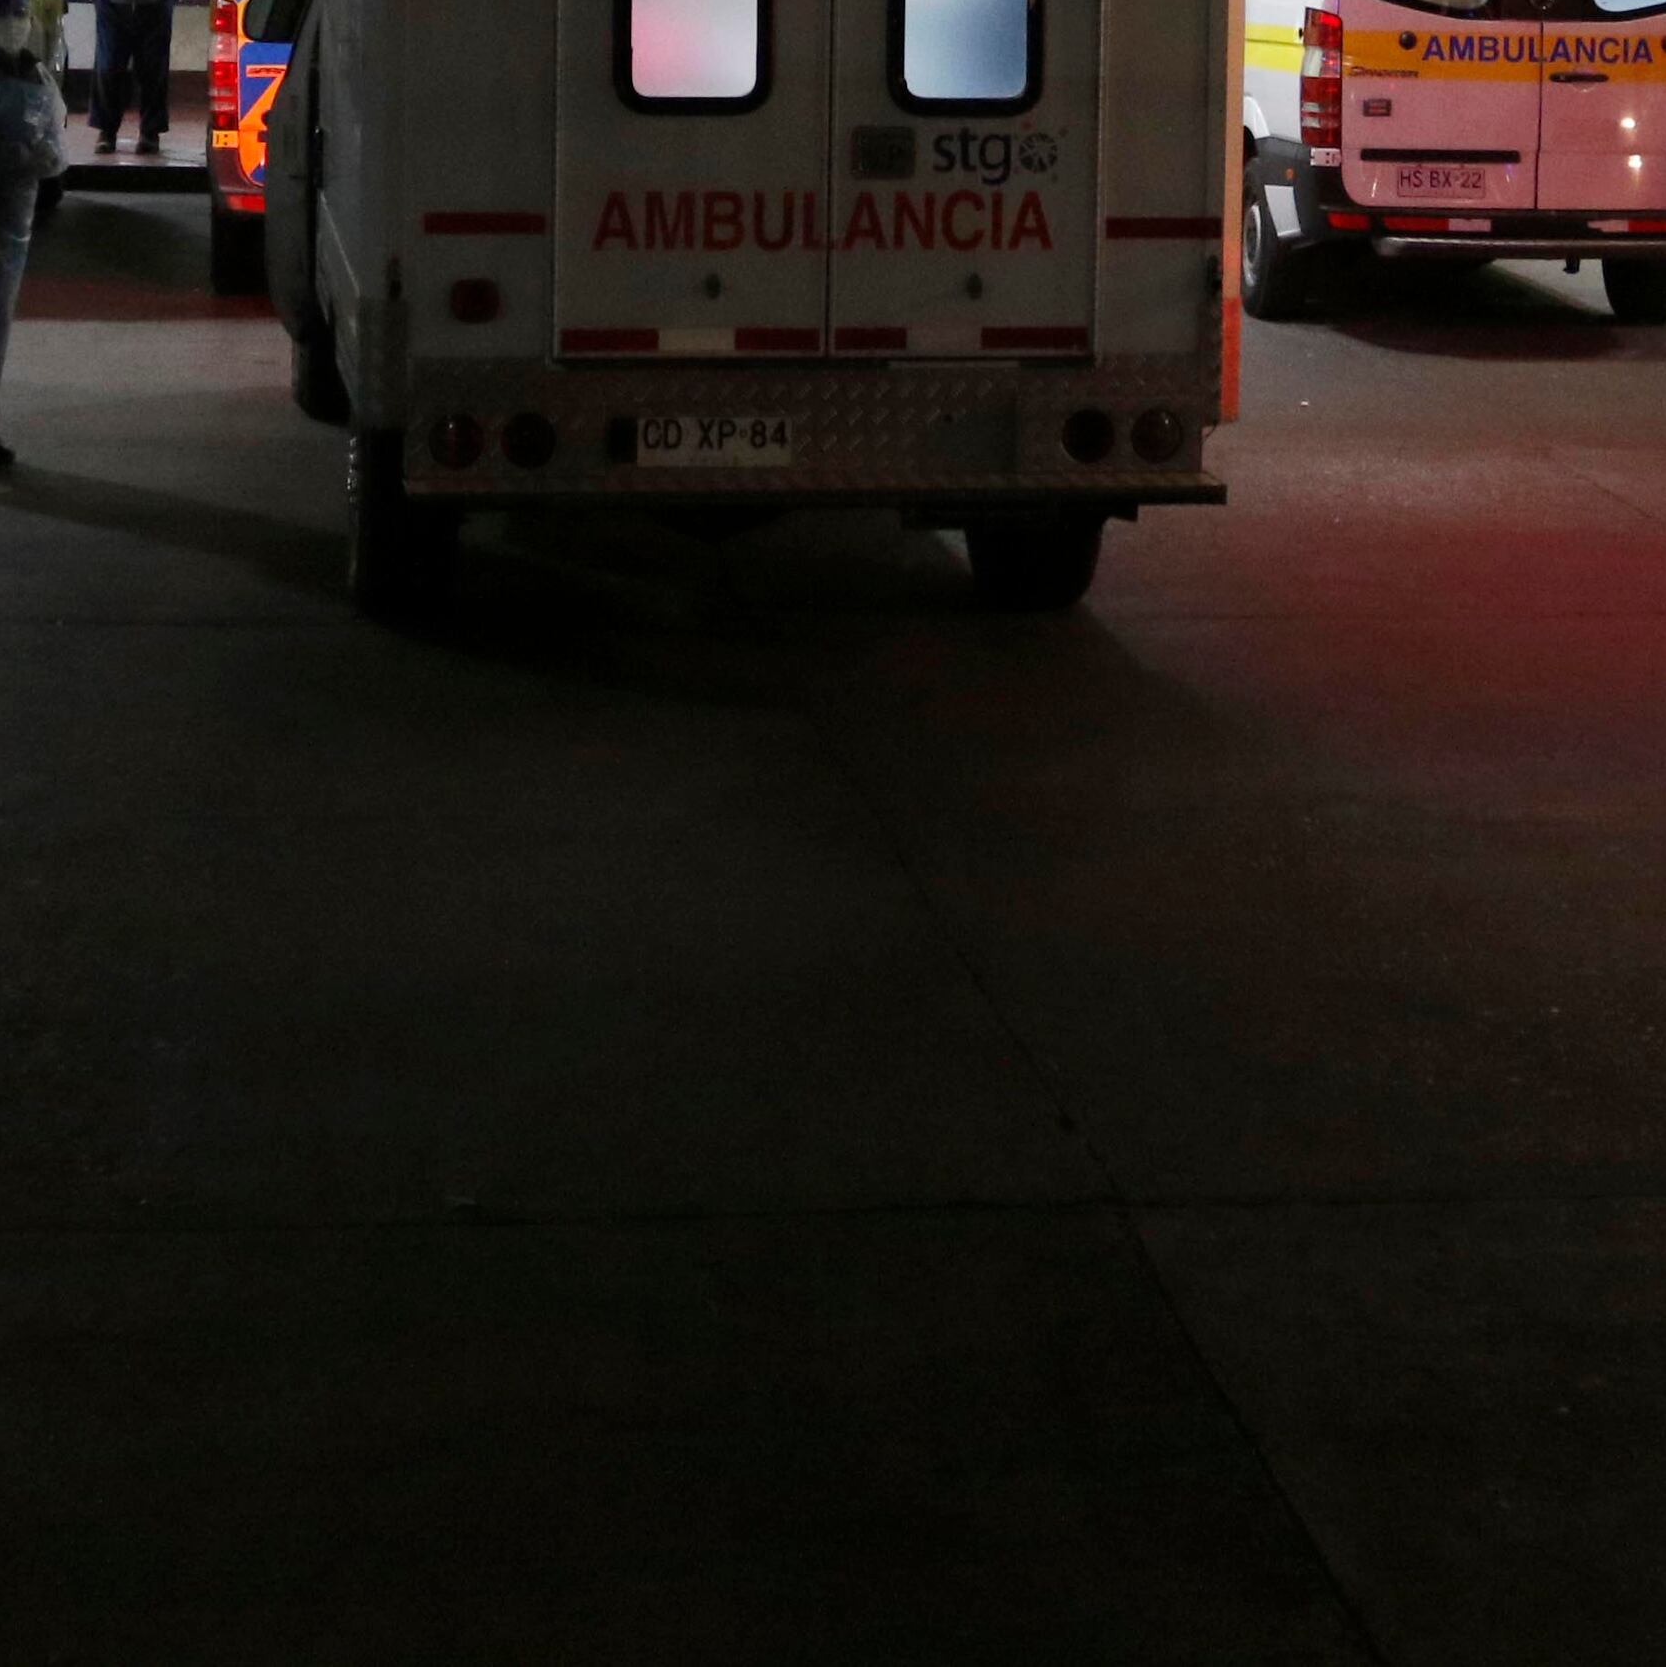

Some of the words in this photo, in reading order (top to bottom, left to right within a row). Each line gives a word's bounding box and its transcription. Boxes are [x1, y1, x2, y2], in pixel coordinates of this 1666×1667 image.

[1422, 35, 1653, 64] AMBULANCIA
[1399, 170, 1423, 188] HS
[591, 190, 1053, 251] AMBULANCIA
[642, 418, 683, 450] CD
